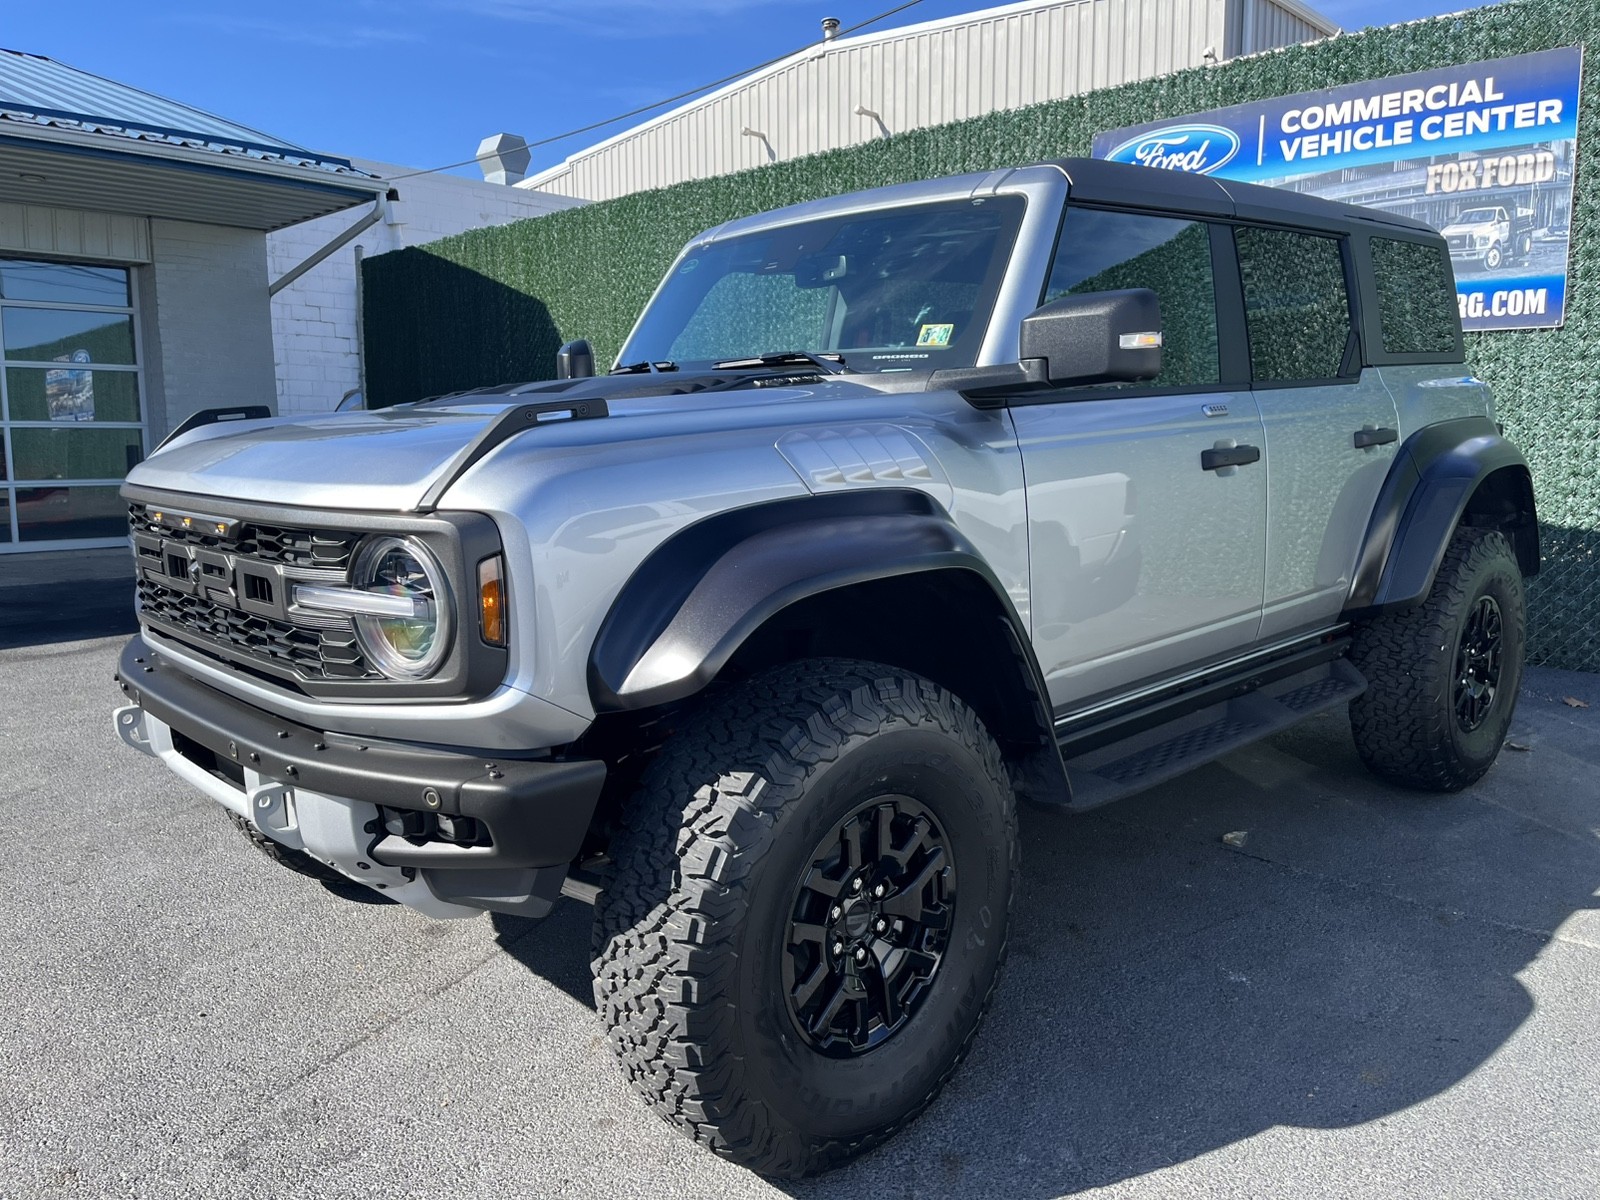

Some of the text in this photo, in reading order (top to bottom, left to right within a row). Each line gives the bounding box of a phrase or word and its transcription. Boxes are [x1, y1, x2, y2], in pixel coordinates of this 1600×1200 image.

[1280, 99, 1563, 162] VEHICLE CENTER
[1281, 77, 1504, 134] COMMERCIAL
[1131, 134, 1210, 172] Ford
[1425, 151, 1555, 195] FOX FORD
[134, 531, 286, 622] FORD
